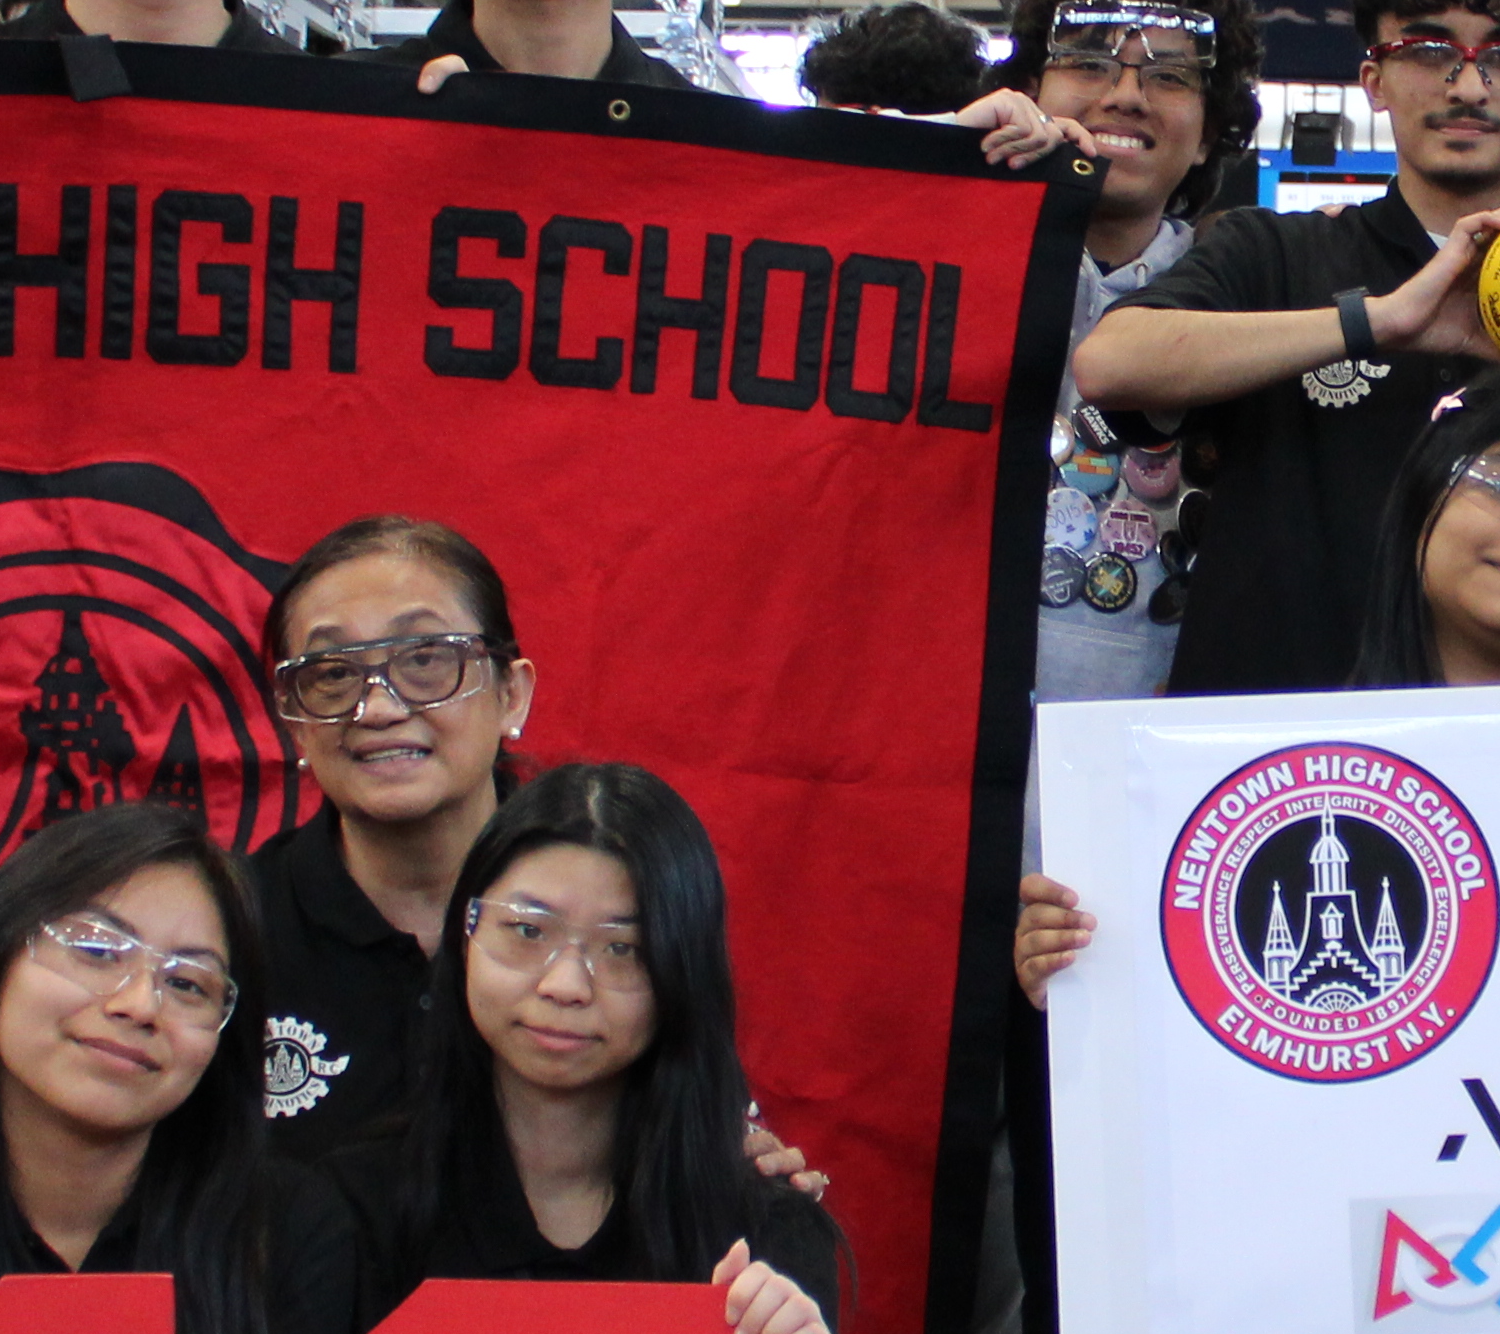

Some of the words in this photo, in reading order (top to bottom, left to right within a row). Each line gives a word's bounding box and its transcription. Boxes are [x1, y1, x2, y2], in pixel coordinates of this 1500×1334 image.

[423, 205, 993, 434] SCHOOL
[1173, 760, 1297, 911] NEWTOWN
[1303, 754, 1396, 792] HIGH
[1394, 775, 1487, 902] SCHOOL
[1228, 808, 1282, 870] RESPECT
[1284, 794, 1381, 815] INTEGRITY
[1382, 808, 1443, 880] DIVERSITY
[1214, 868, 1257, 997] PERSEVERANCE
[1412, 884, 1450, 989] EXCELLENCE
[1215, 1003, 1393, 1073] ELMHURST
[1394, 1001, 1457, 1053] N.Y.
[1263, 998, 1360, 1033] FOUNDED
[1365, 991, 1411, 1025] 1897
